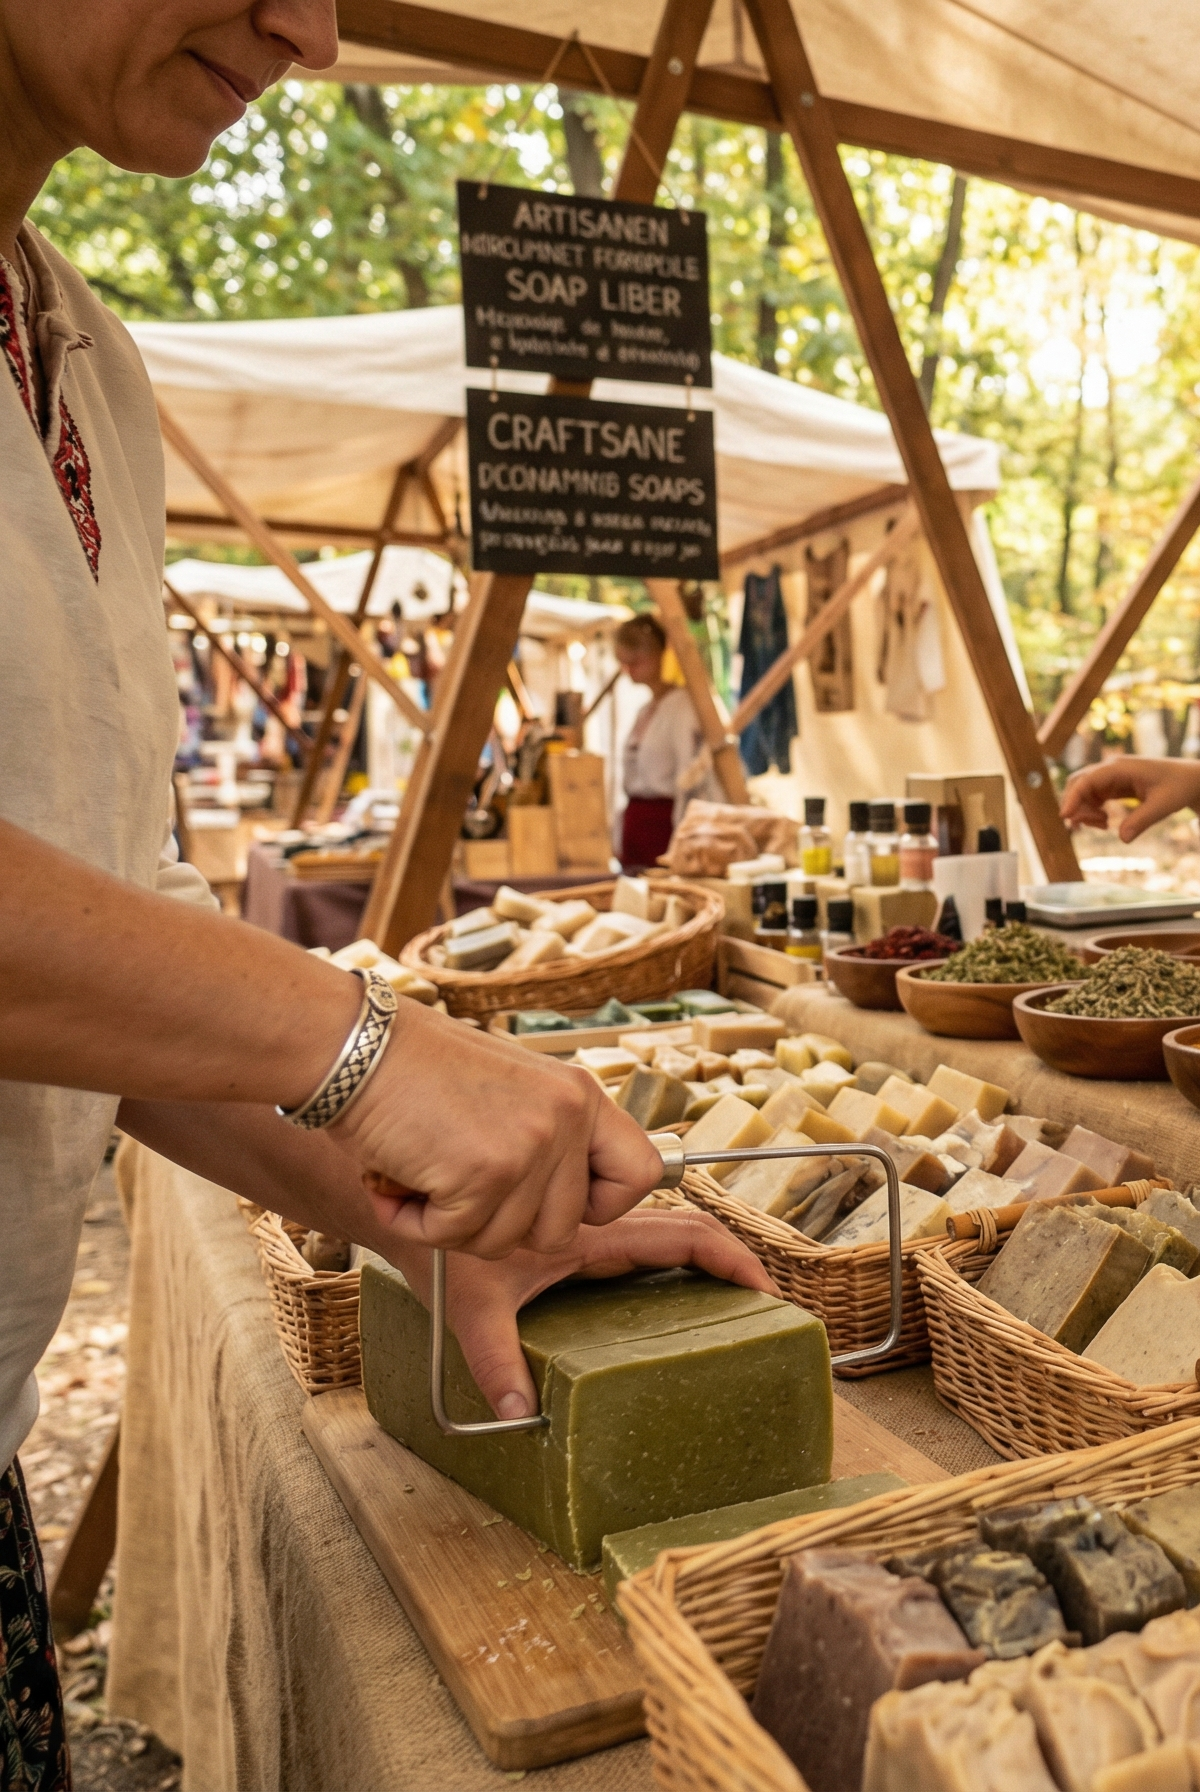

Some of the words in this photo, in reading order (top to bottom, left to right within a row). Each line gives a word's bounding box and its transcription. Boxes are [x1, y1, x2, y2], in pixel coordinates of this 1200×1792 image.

[505, 267, 589, 307] SOAP
[600, 279, 682, 318] LIBER
[487, 412, 687, 464] CRAFTSANE
[628, 472, 706, 506] SOAPS
